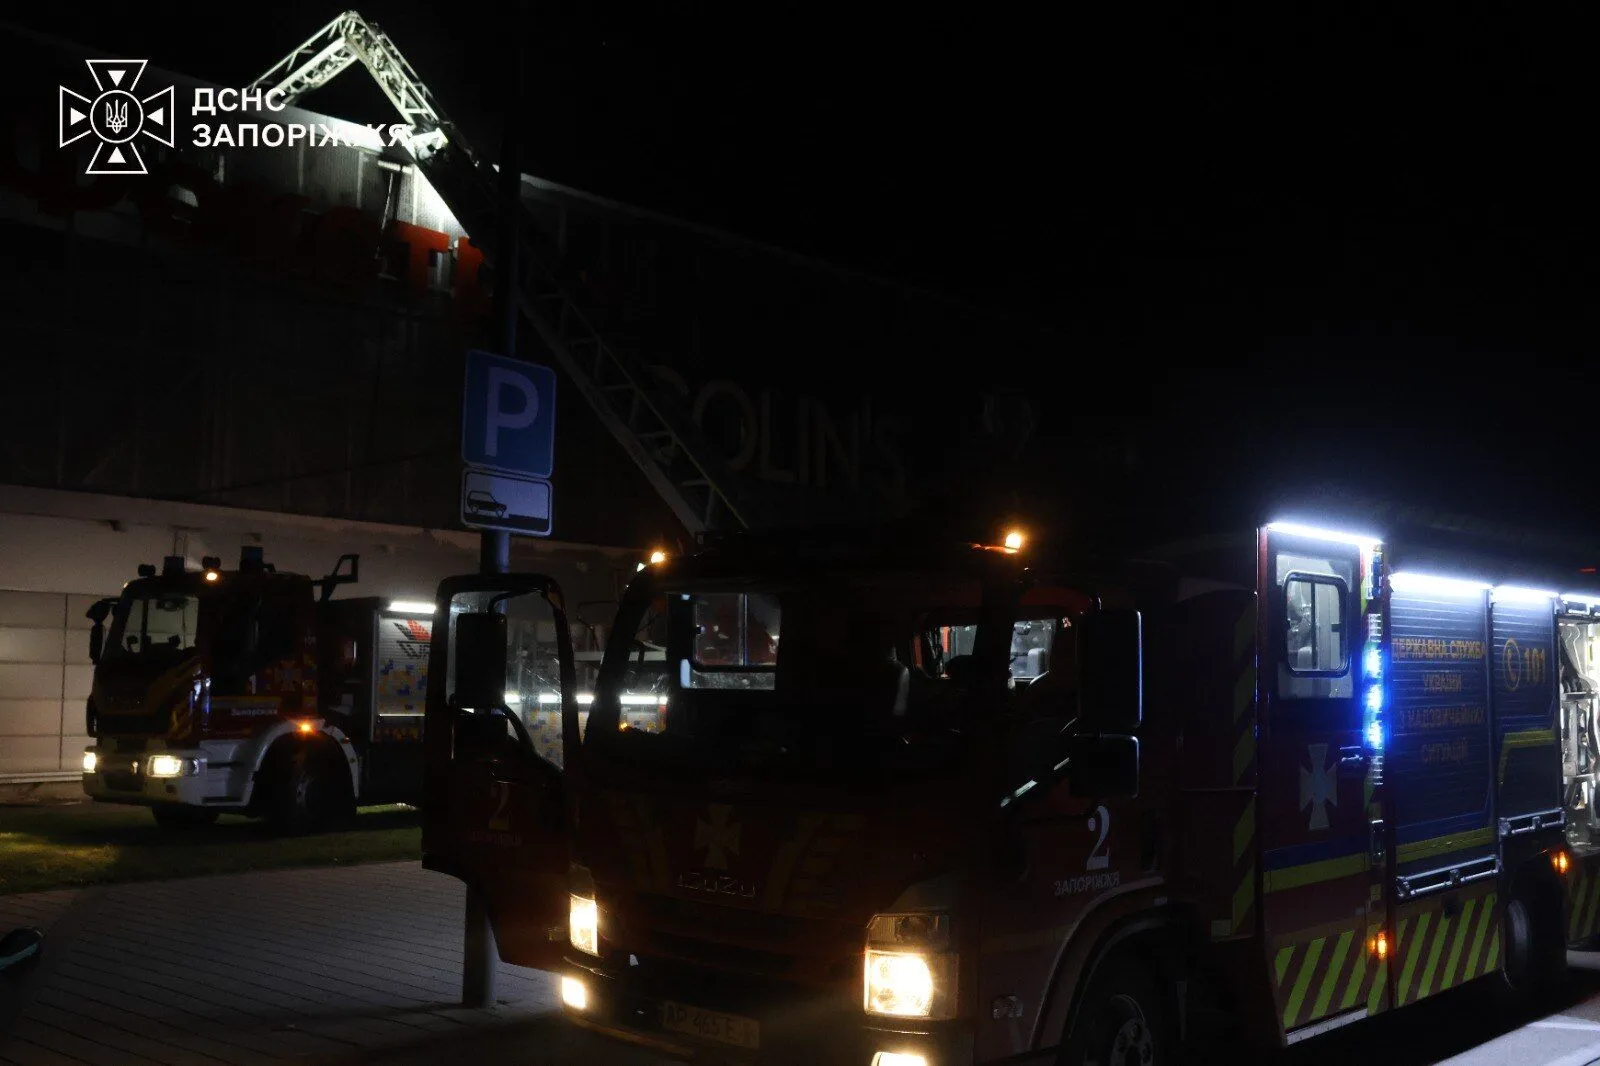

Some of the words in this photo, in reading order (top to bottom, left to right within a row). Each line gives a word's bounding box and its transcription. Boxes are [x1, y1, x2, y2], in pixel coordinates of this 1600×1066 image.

[484, 366, 539, 457] P
[1524, 648, 1546, 684] 101
[1086, 805, 1110, 871] 2
[1053, 871, 1120, 897] ЗАПОРІЖЖЯ
